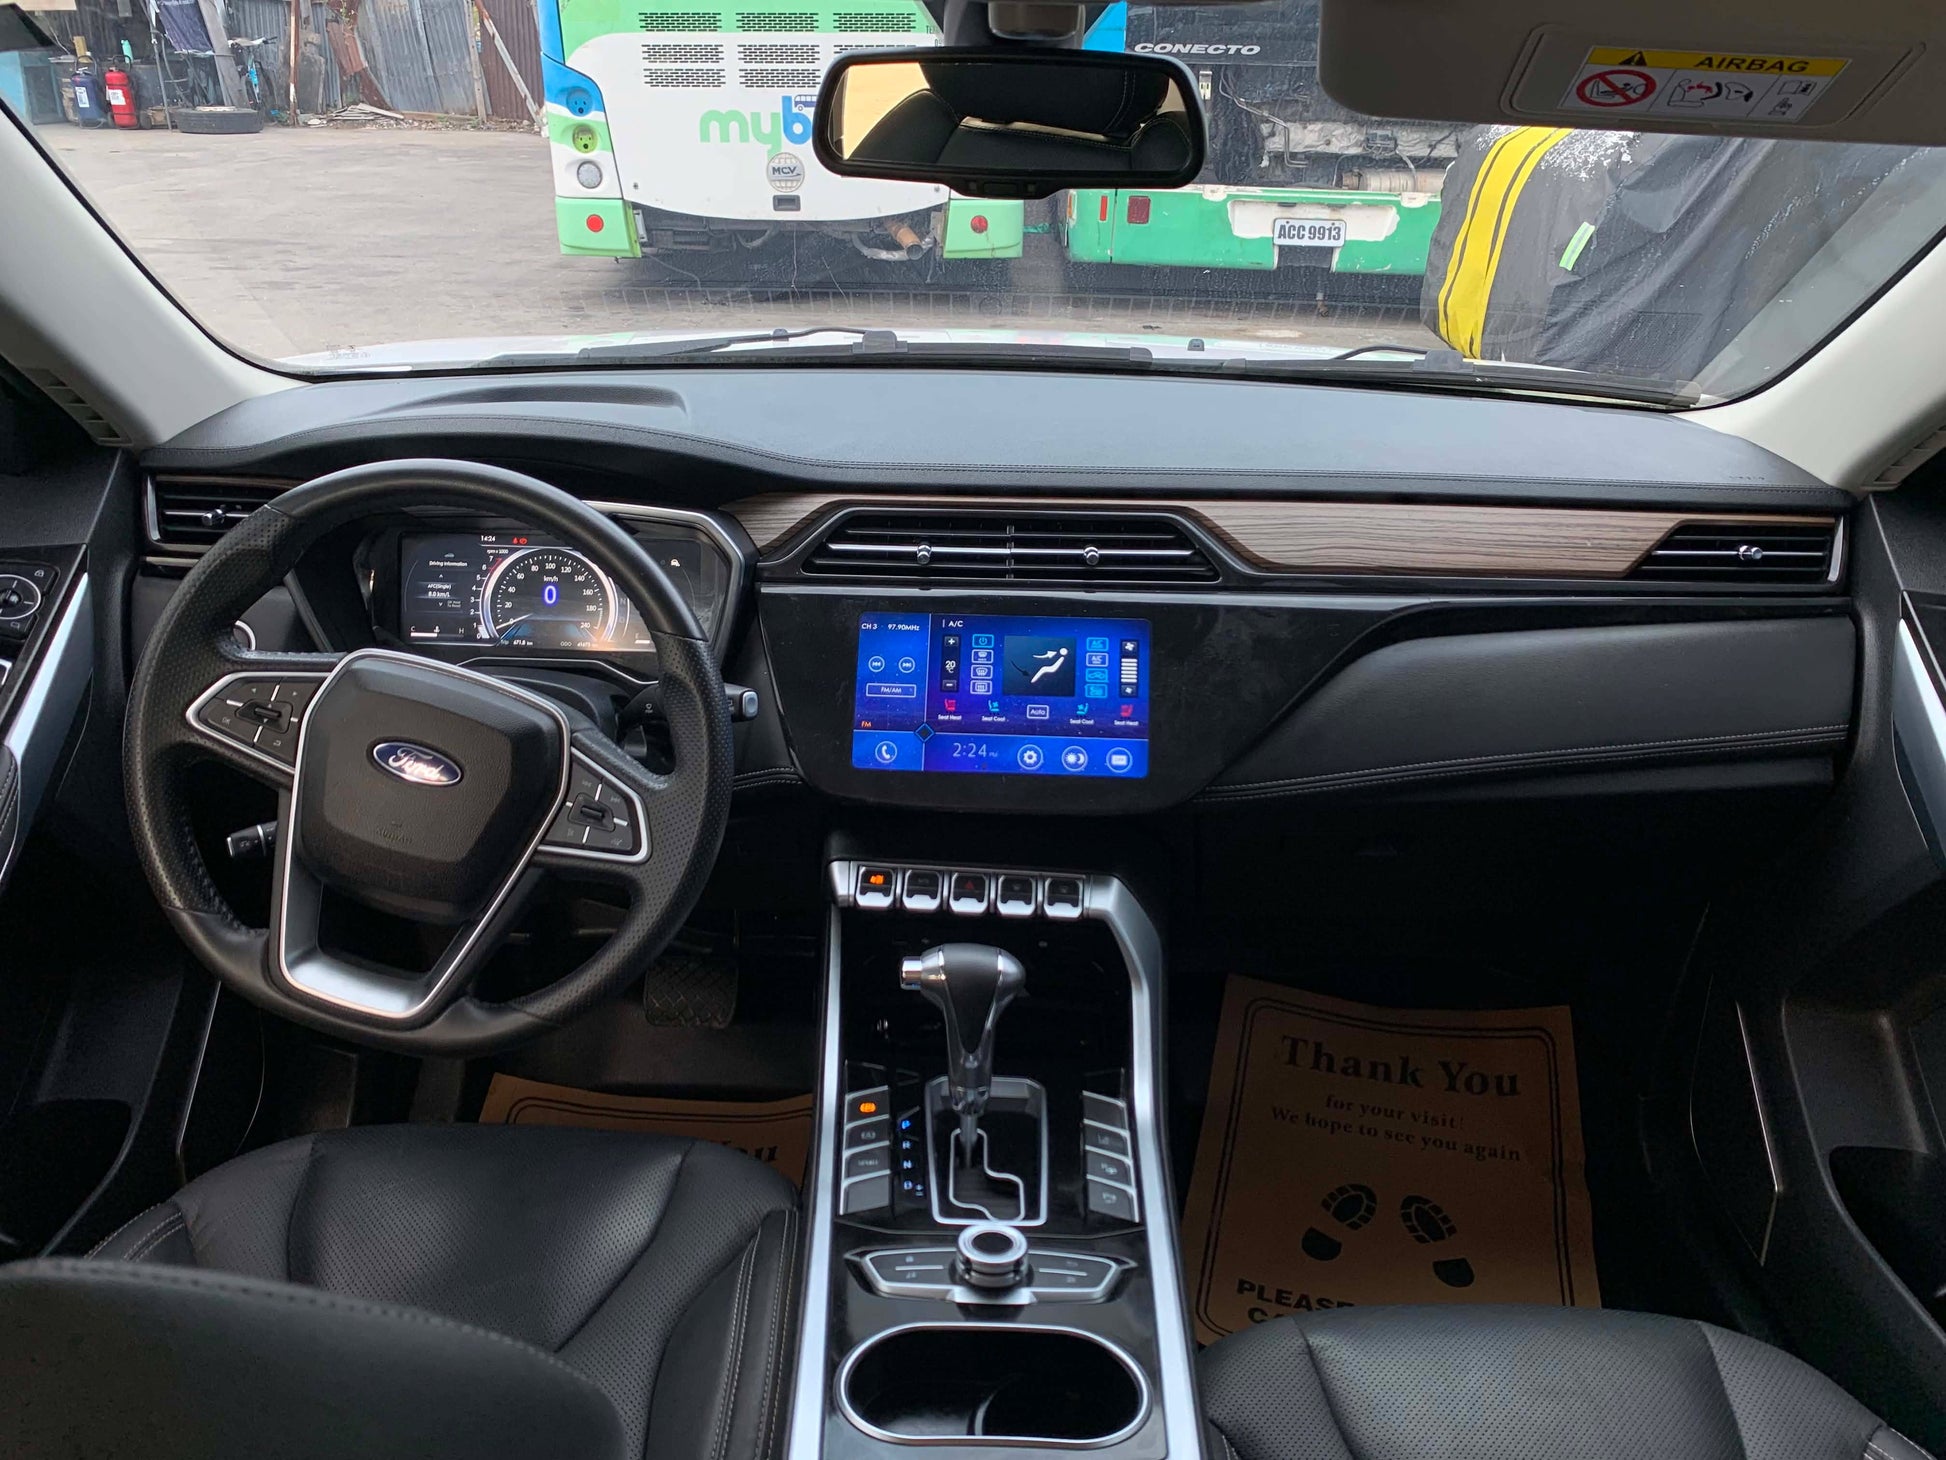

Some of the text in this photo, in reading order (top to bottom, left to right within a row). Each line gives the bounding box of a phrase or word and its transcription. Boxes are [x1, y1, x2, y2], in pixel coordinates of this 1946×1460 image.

[1134, 43, 1261, 55] CONECTO
[1694, 56, 1810, 73] AIRBAG
[699, 95, 813, 161] myb
[772, 166, 797, 175] MCV
[1277, 224, 1342, 241] ACC 9913
[544, 585, 557, 604] 0
[948, 620, 964, 628] A/C
[945, 660, 956, 669] 20
[952, 743, 987, 758] 2:24
[1281, 1034, 1521, 1097] Thank You
[1325, 1094, 1465, 1130] for your visit!
[1271, 1106, 1521, 1162] We hope to see you again
[903, 1160, 912, 1169] N
